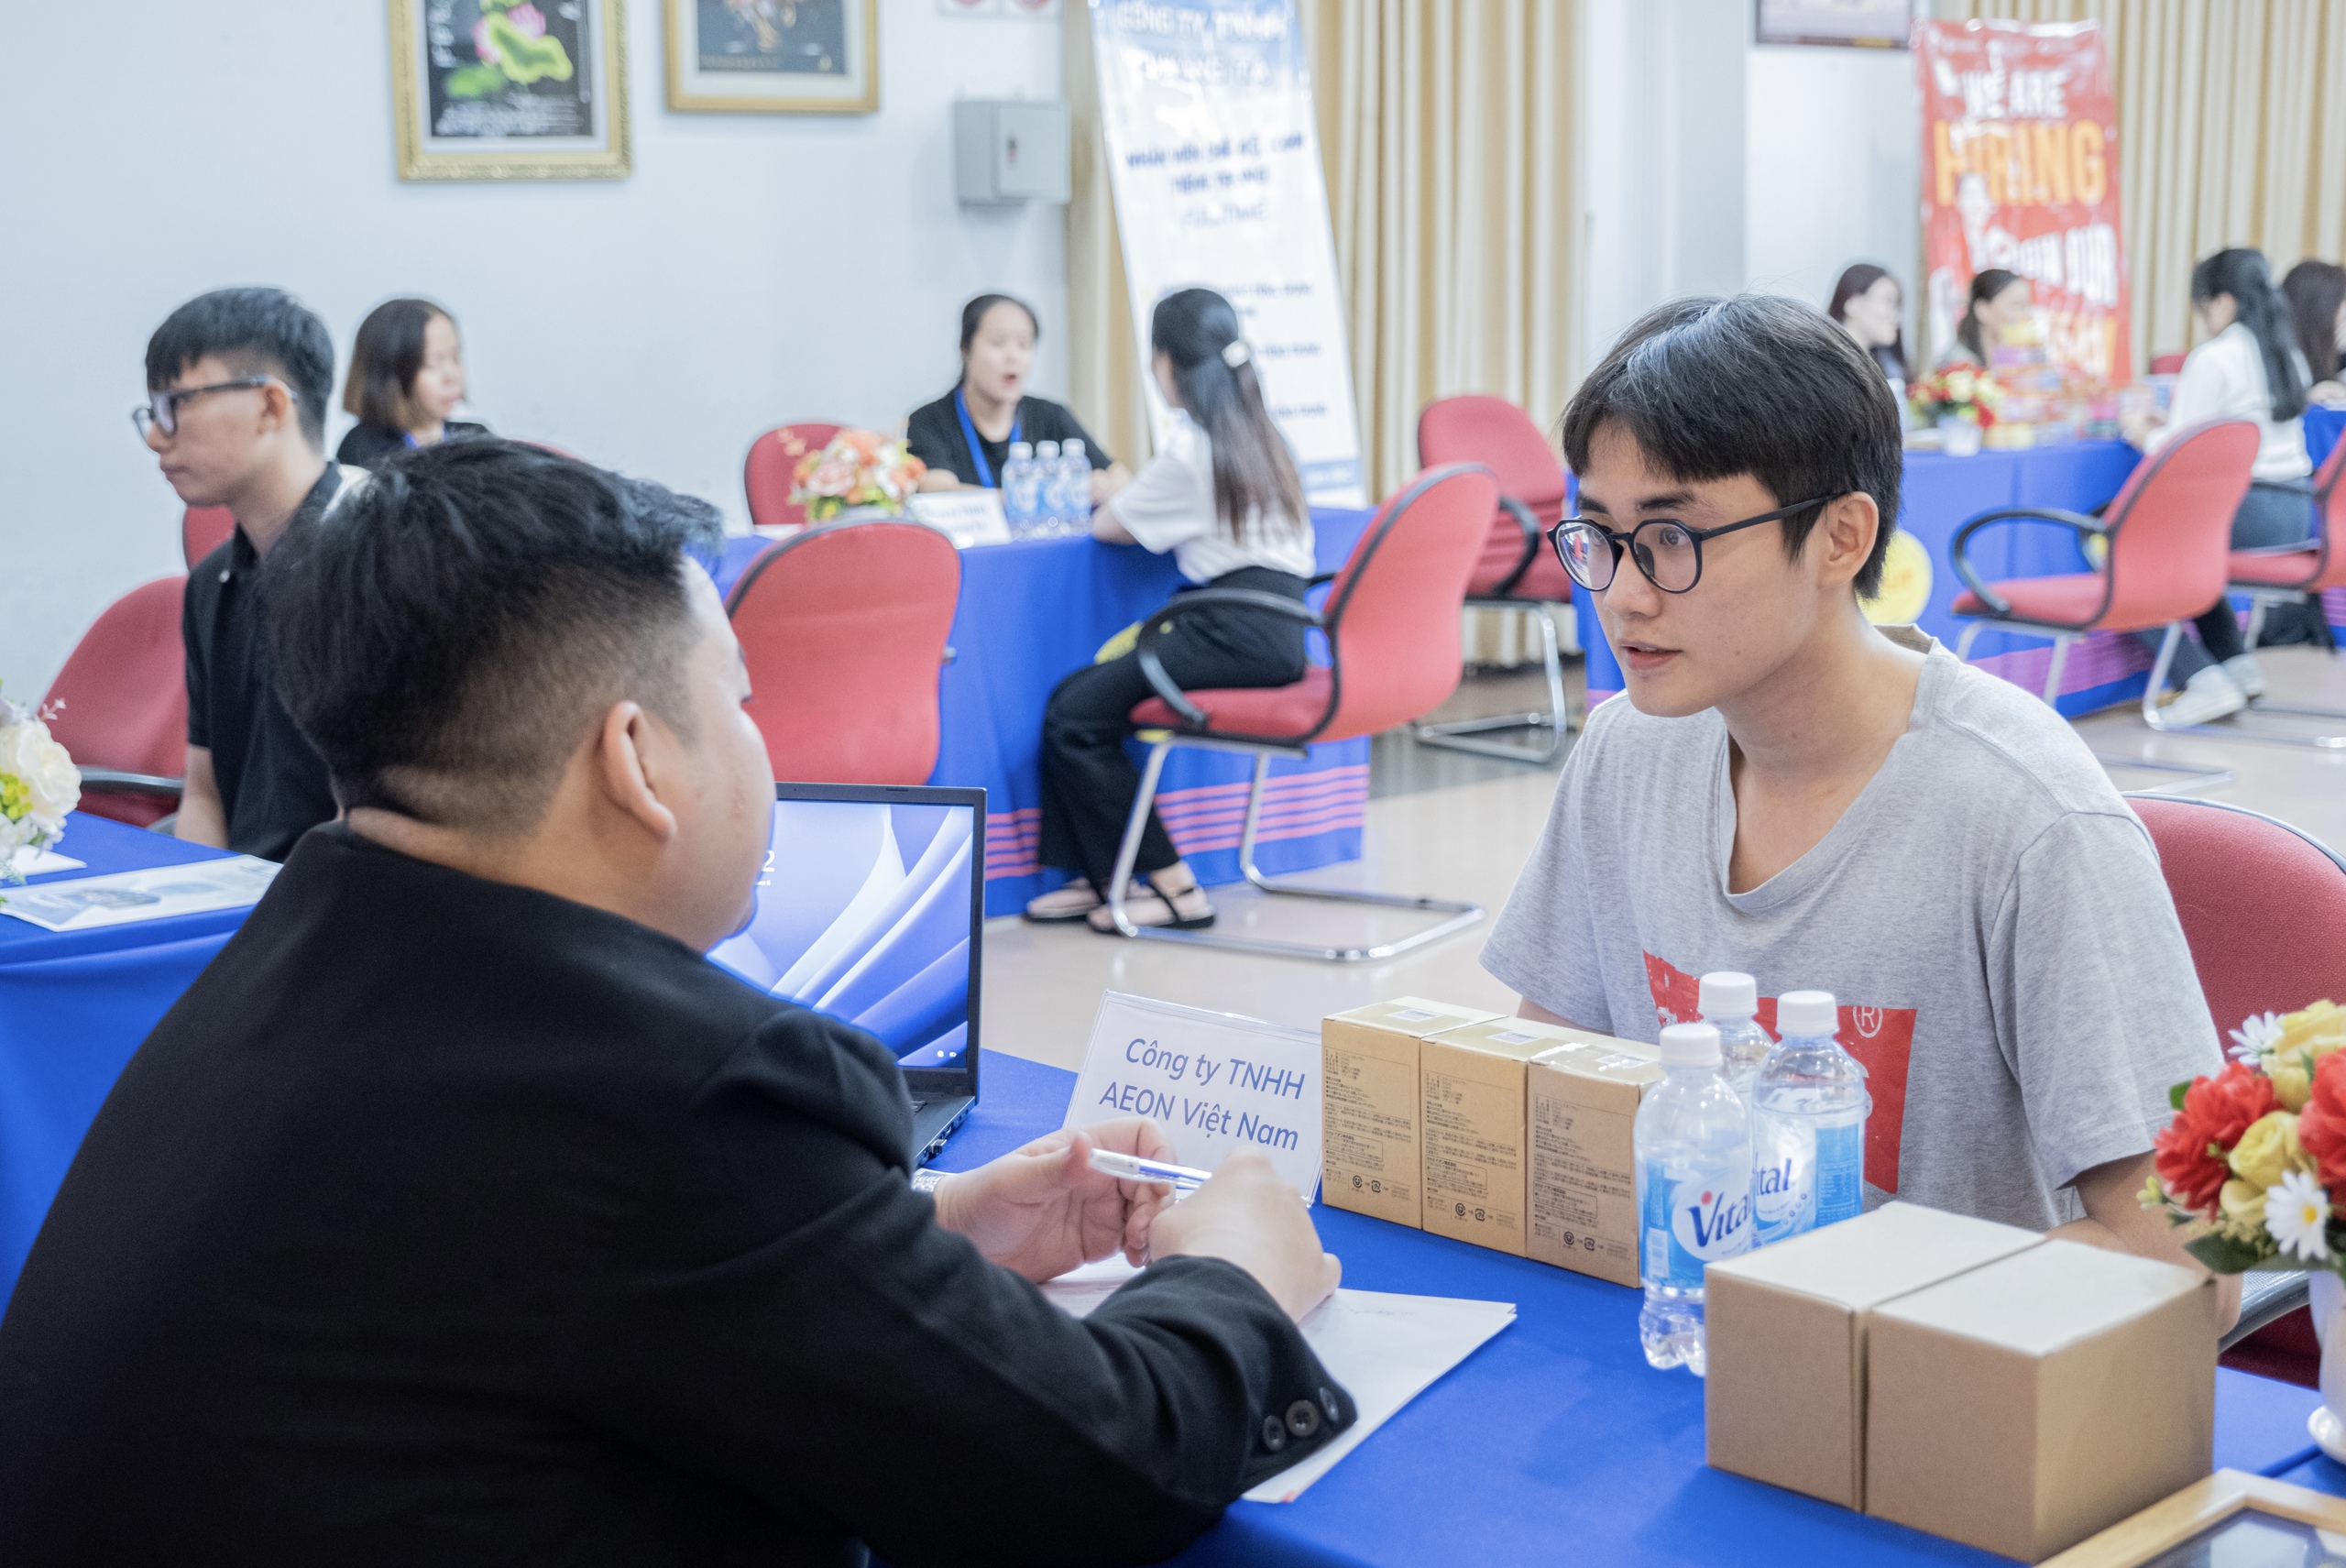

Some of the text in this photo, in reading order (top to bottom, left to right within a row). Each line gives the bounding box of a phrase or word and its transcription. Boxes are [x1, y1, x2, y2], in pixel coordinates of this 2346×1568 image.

[2010, 70, 2069, 116] ARE
[1934, 118, 2107, 204] HIRING
[1125, 1037, 1189, 1080] Công
[1195, 1054, 1221, 1087] ty
[1229, 1058, 1306, 1100] TNHH
[1099, 1081, 1176, 1121] AEON
[1183, 1098, 1232, 1138] Việt
[1236, 1112, 1299, 1151] Nam
